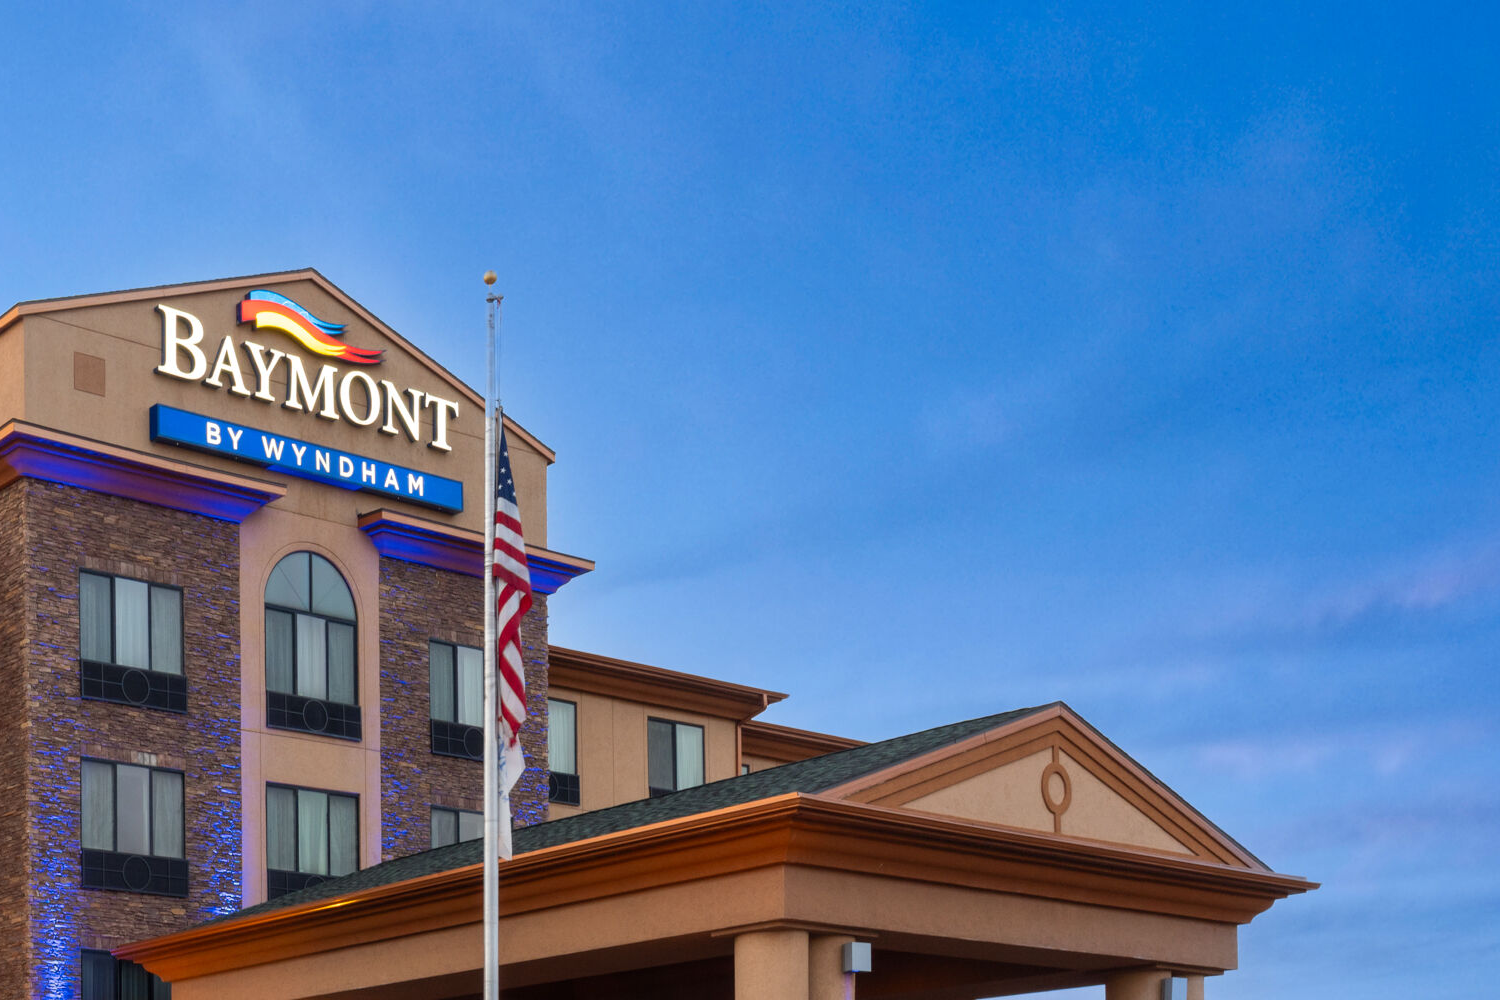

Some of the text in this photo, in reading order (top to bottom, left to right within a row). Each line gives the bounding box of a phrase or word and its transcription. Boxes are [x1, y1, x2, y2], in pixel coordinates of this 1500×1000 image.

[157, 304, 459, 452] BAYMONT
[206, 421, 424, 497] BY WYNDHAM
